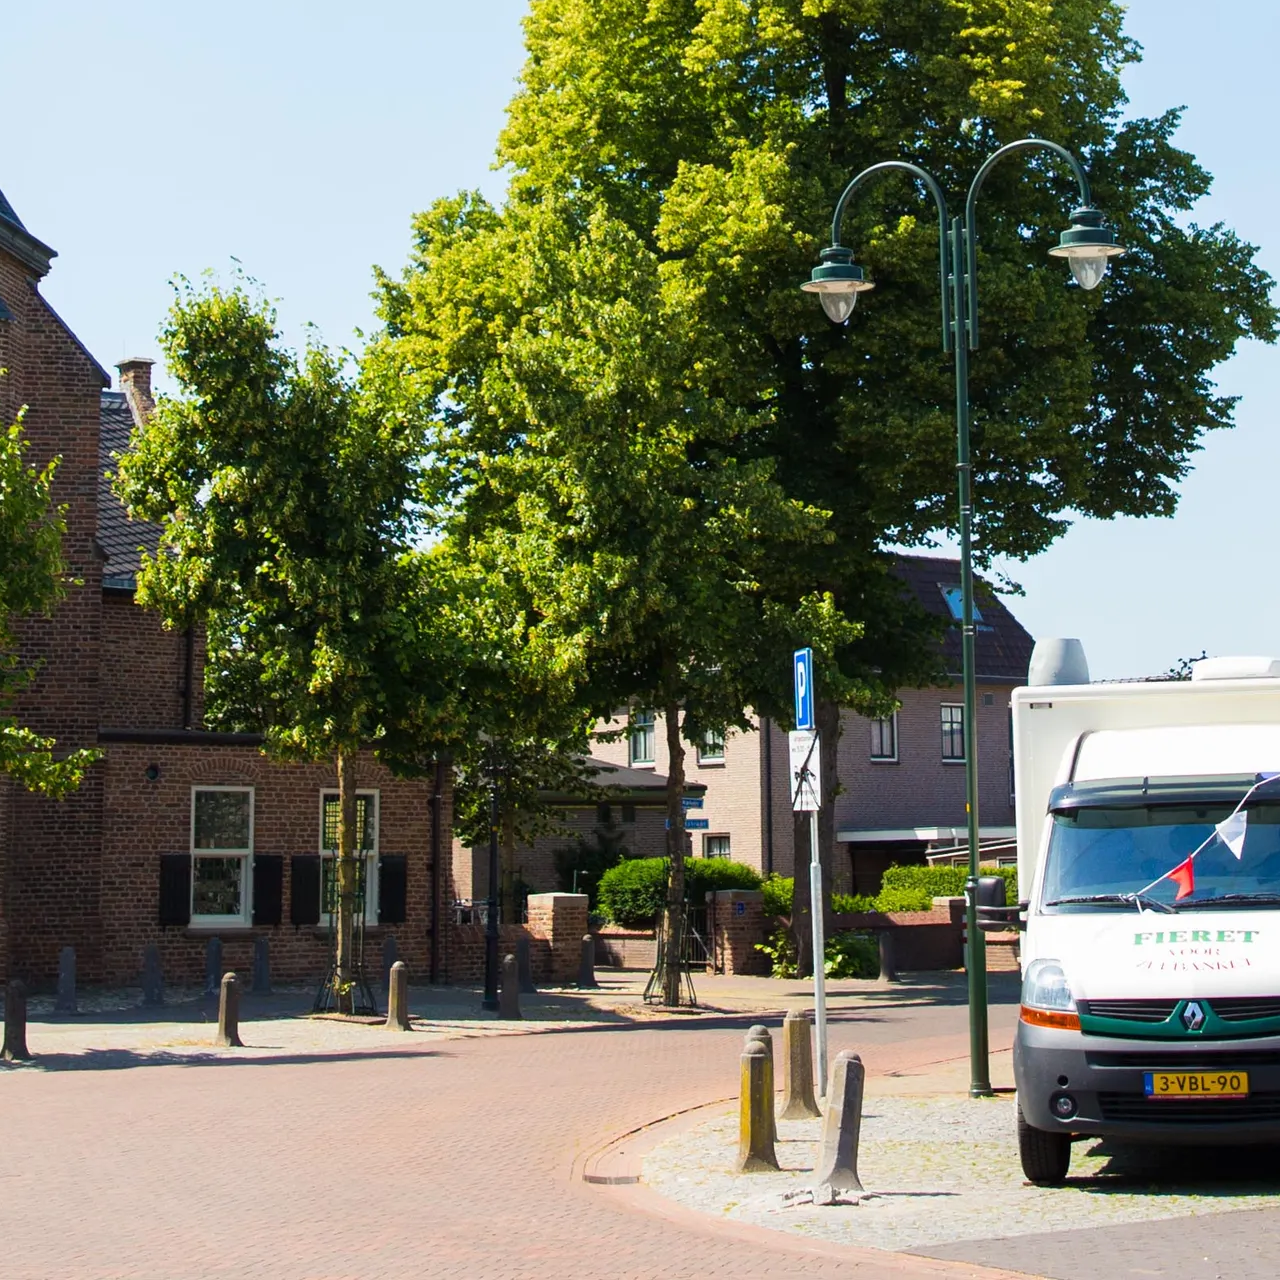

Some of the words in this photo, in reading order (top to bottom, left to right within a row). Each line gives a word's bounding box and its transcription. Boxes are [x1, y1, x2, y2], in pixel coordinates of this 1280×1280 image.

[797, 661, 806, 719] P
[1133, 929, 1260, 945] FIERET
[1160, 1076, 1241, 1091] 3-VBL-90
